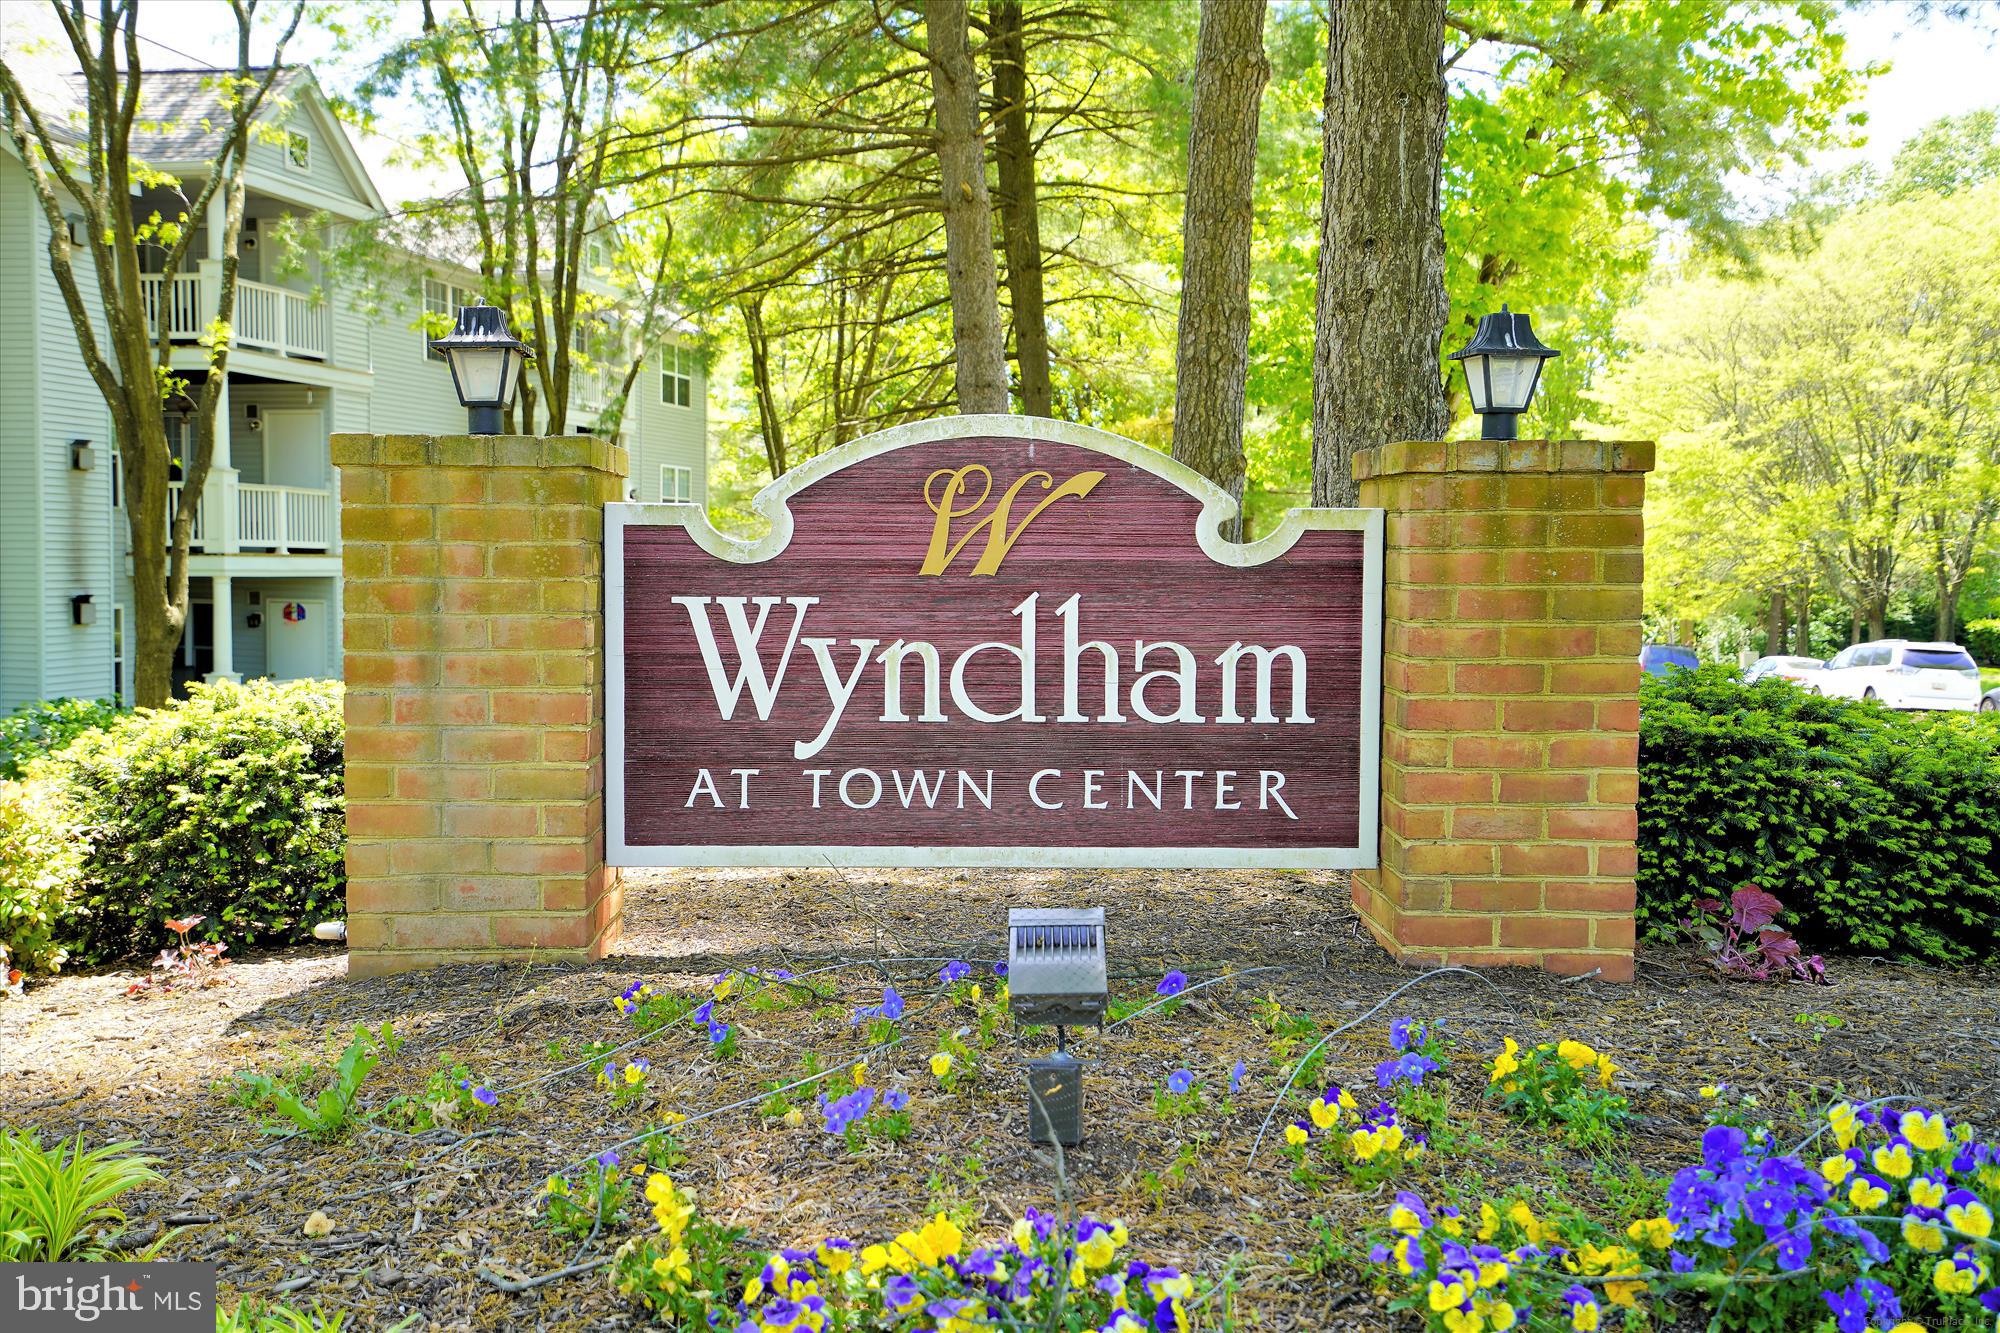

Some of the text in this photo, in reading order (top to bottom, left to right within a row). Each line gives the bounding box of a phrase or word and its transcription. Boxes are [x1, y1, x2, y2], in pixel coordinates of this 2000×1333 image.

[671, 591, 1316, 760] Wyndham
[684, 769, 1299, 820] AT TOWN CENTER
